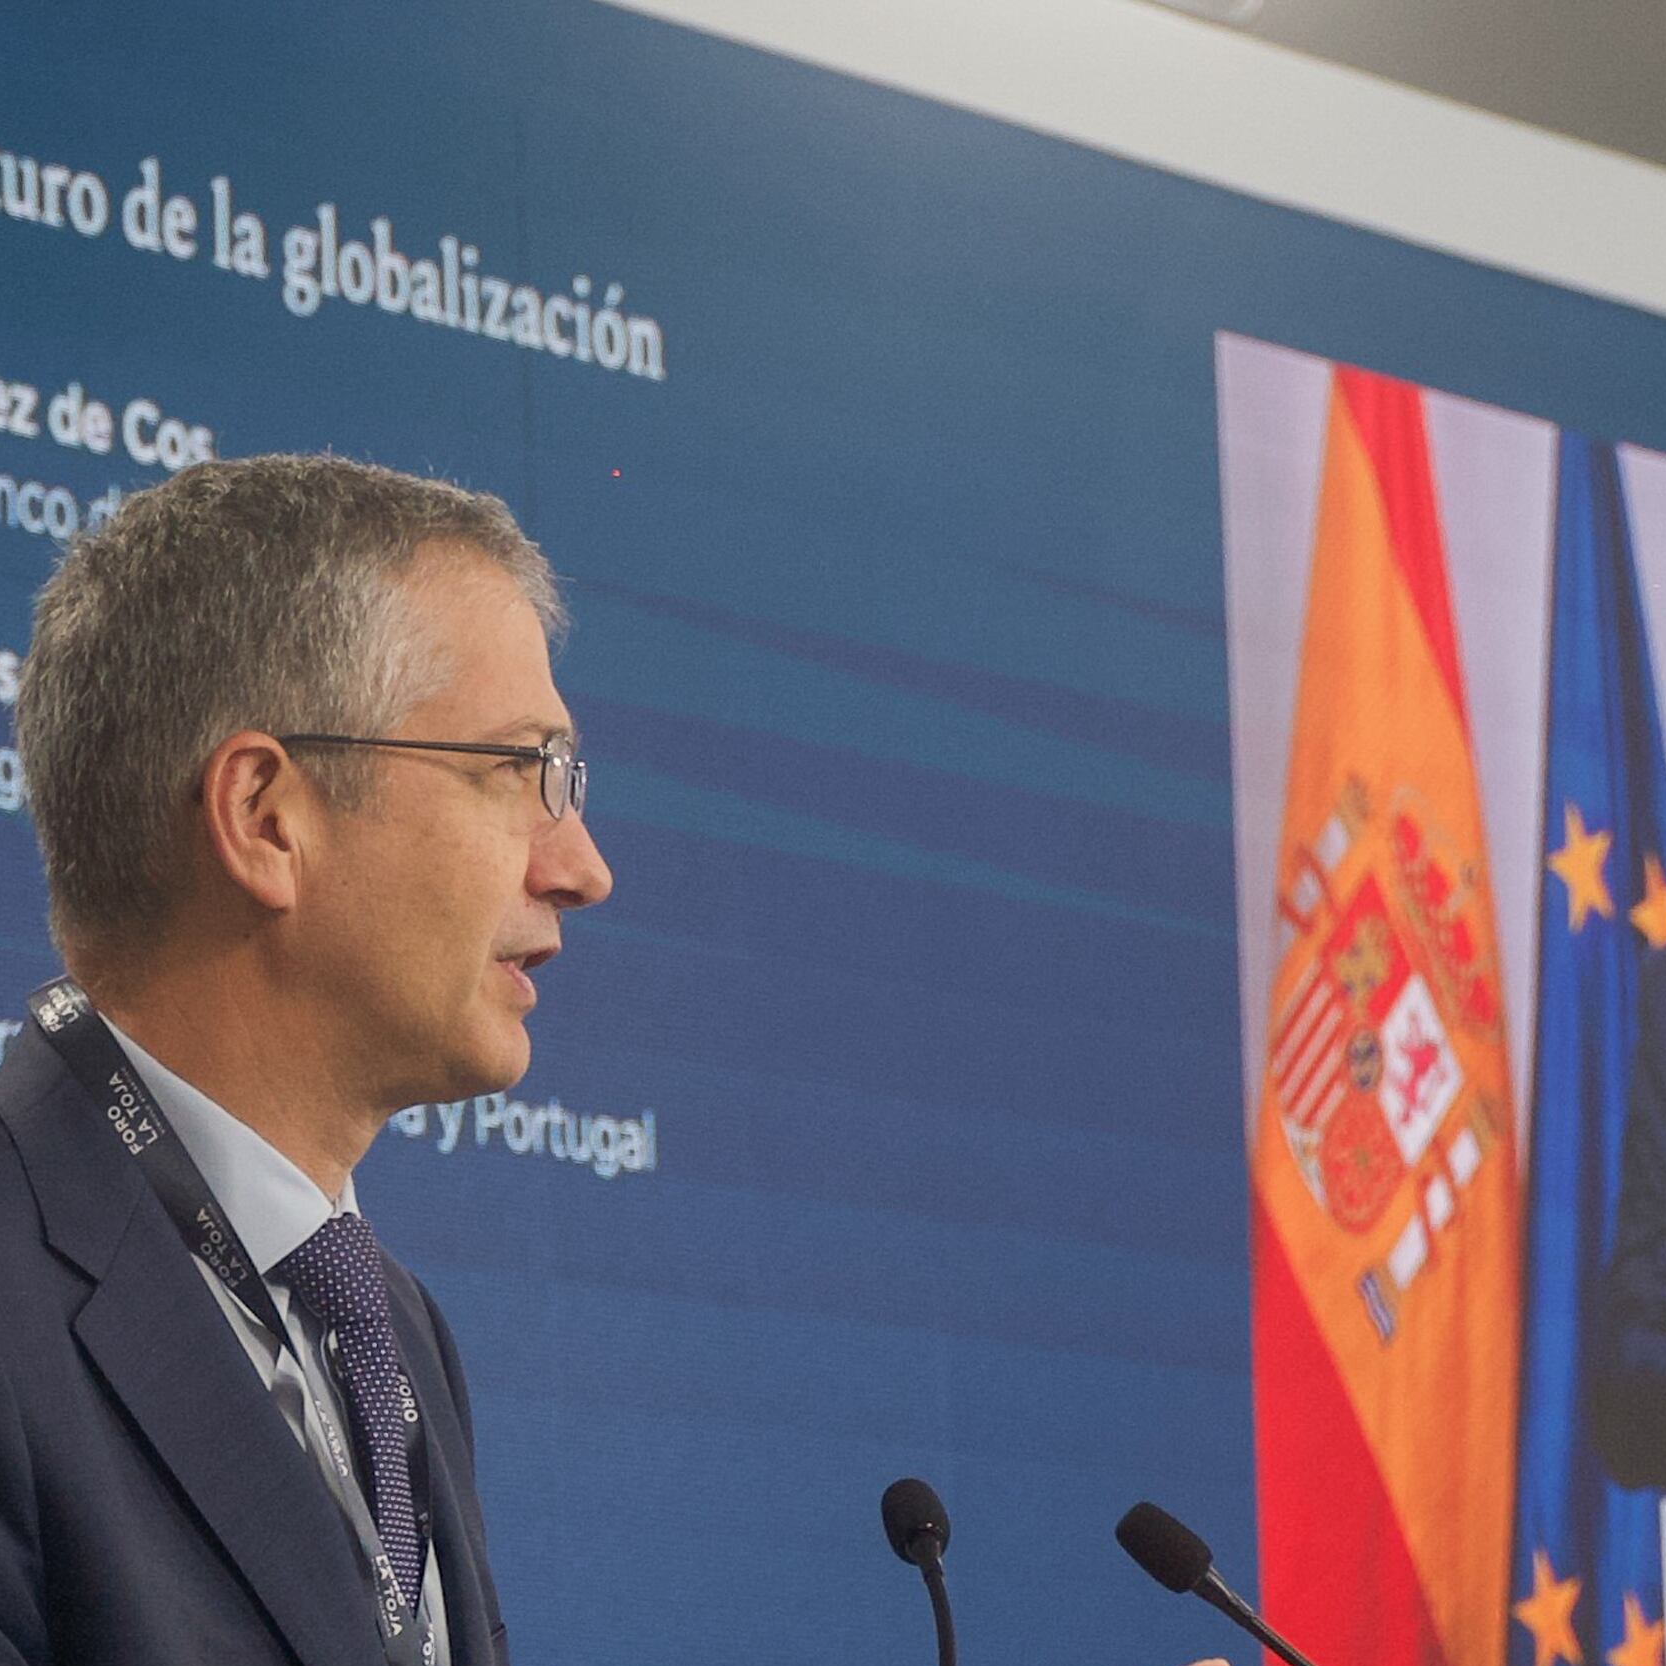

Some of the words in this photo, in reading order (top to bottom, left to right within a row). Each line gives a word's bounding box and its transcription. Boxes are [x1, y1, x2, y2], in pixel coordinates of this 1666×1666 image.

[123, 157, 197, 260] de
[212, 176, 267, 279] la
[283, 203, 666, 381] globalización
[49, 376, 113, 453] de
[122, 400, 214, 471] Cos
[108, 1071, 142, 1121] TOJA
[107, 1105, 144, 1156] FORO
[137, 1118, 159, 1144] LA
[474, 1092, 656, 1178] Portugal
[397, 1374, 419, 1423] FORO
